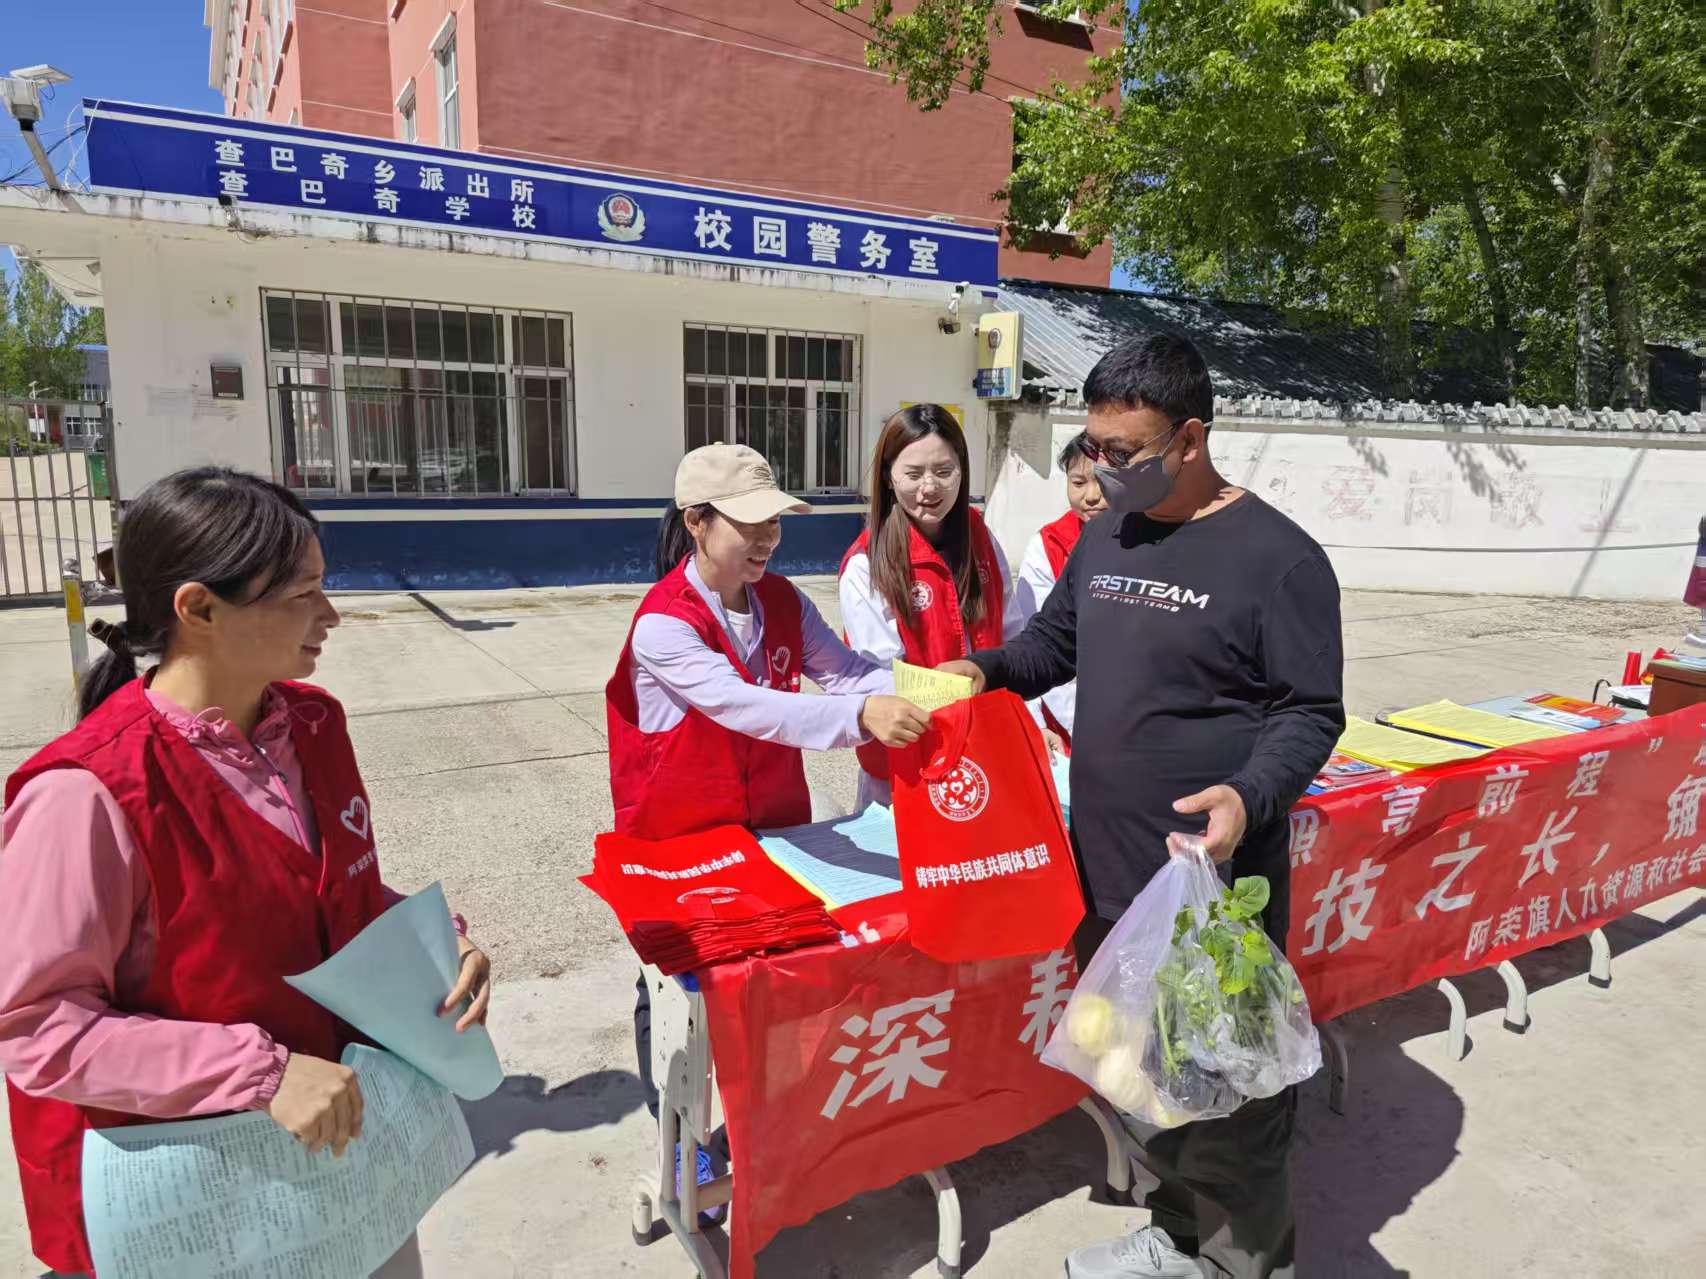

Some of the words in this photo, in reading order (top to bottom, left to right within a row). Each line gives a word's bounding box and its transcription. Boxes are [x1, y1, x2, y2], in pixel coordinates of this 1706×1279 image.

[215, 140, 534, 203] 查巴奇乡派出所
[219, 170, 536, 229] 查巴奇学校
[694, 207, 939, 275] 校园警务室
[916, 843, 1050, 888] 铸牢中华民族共同体意识
